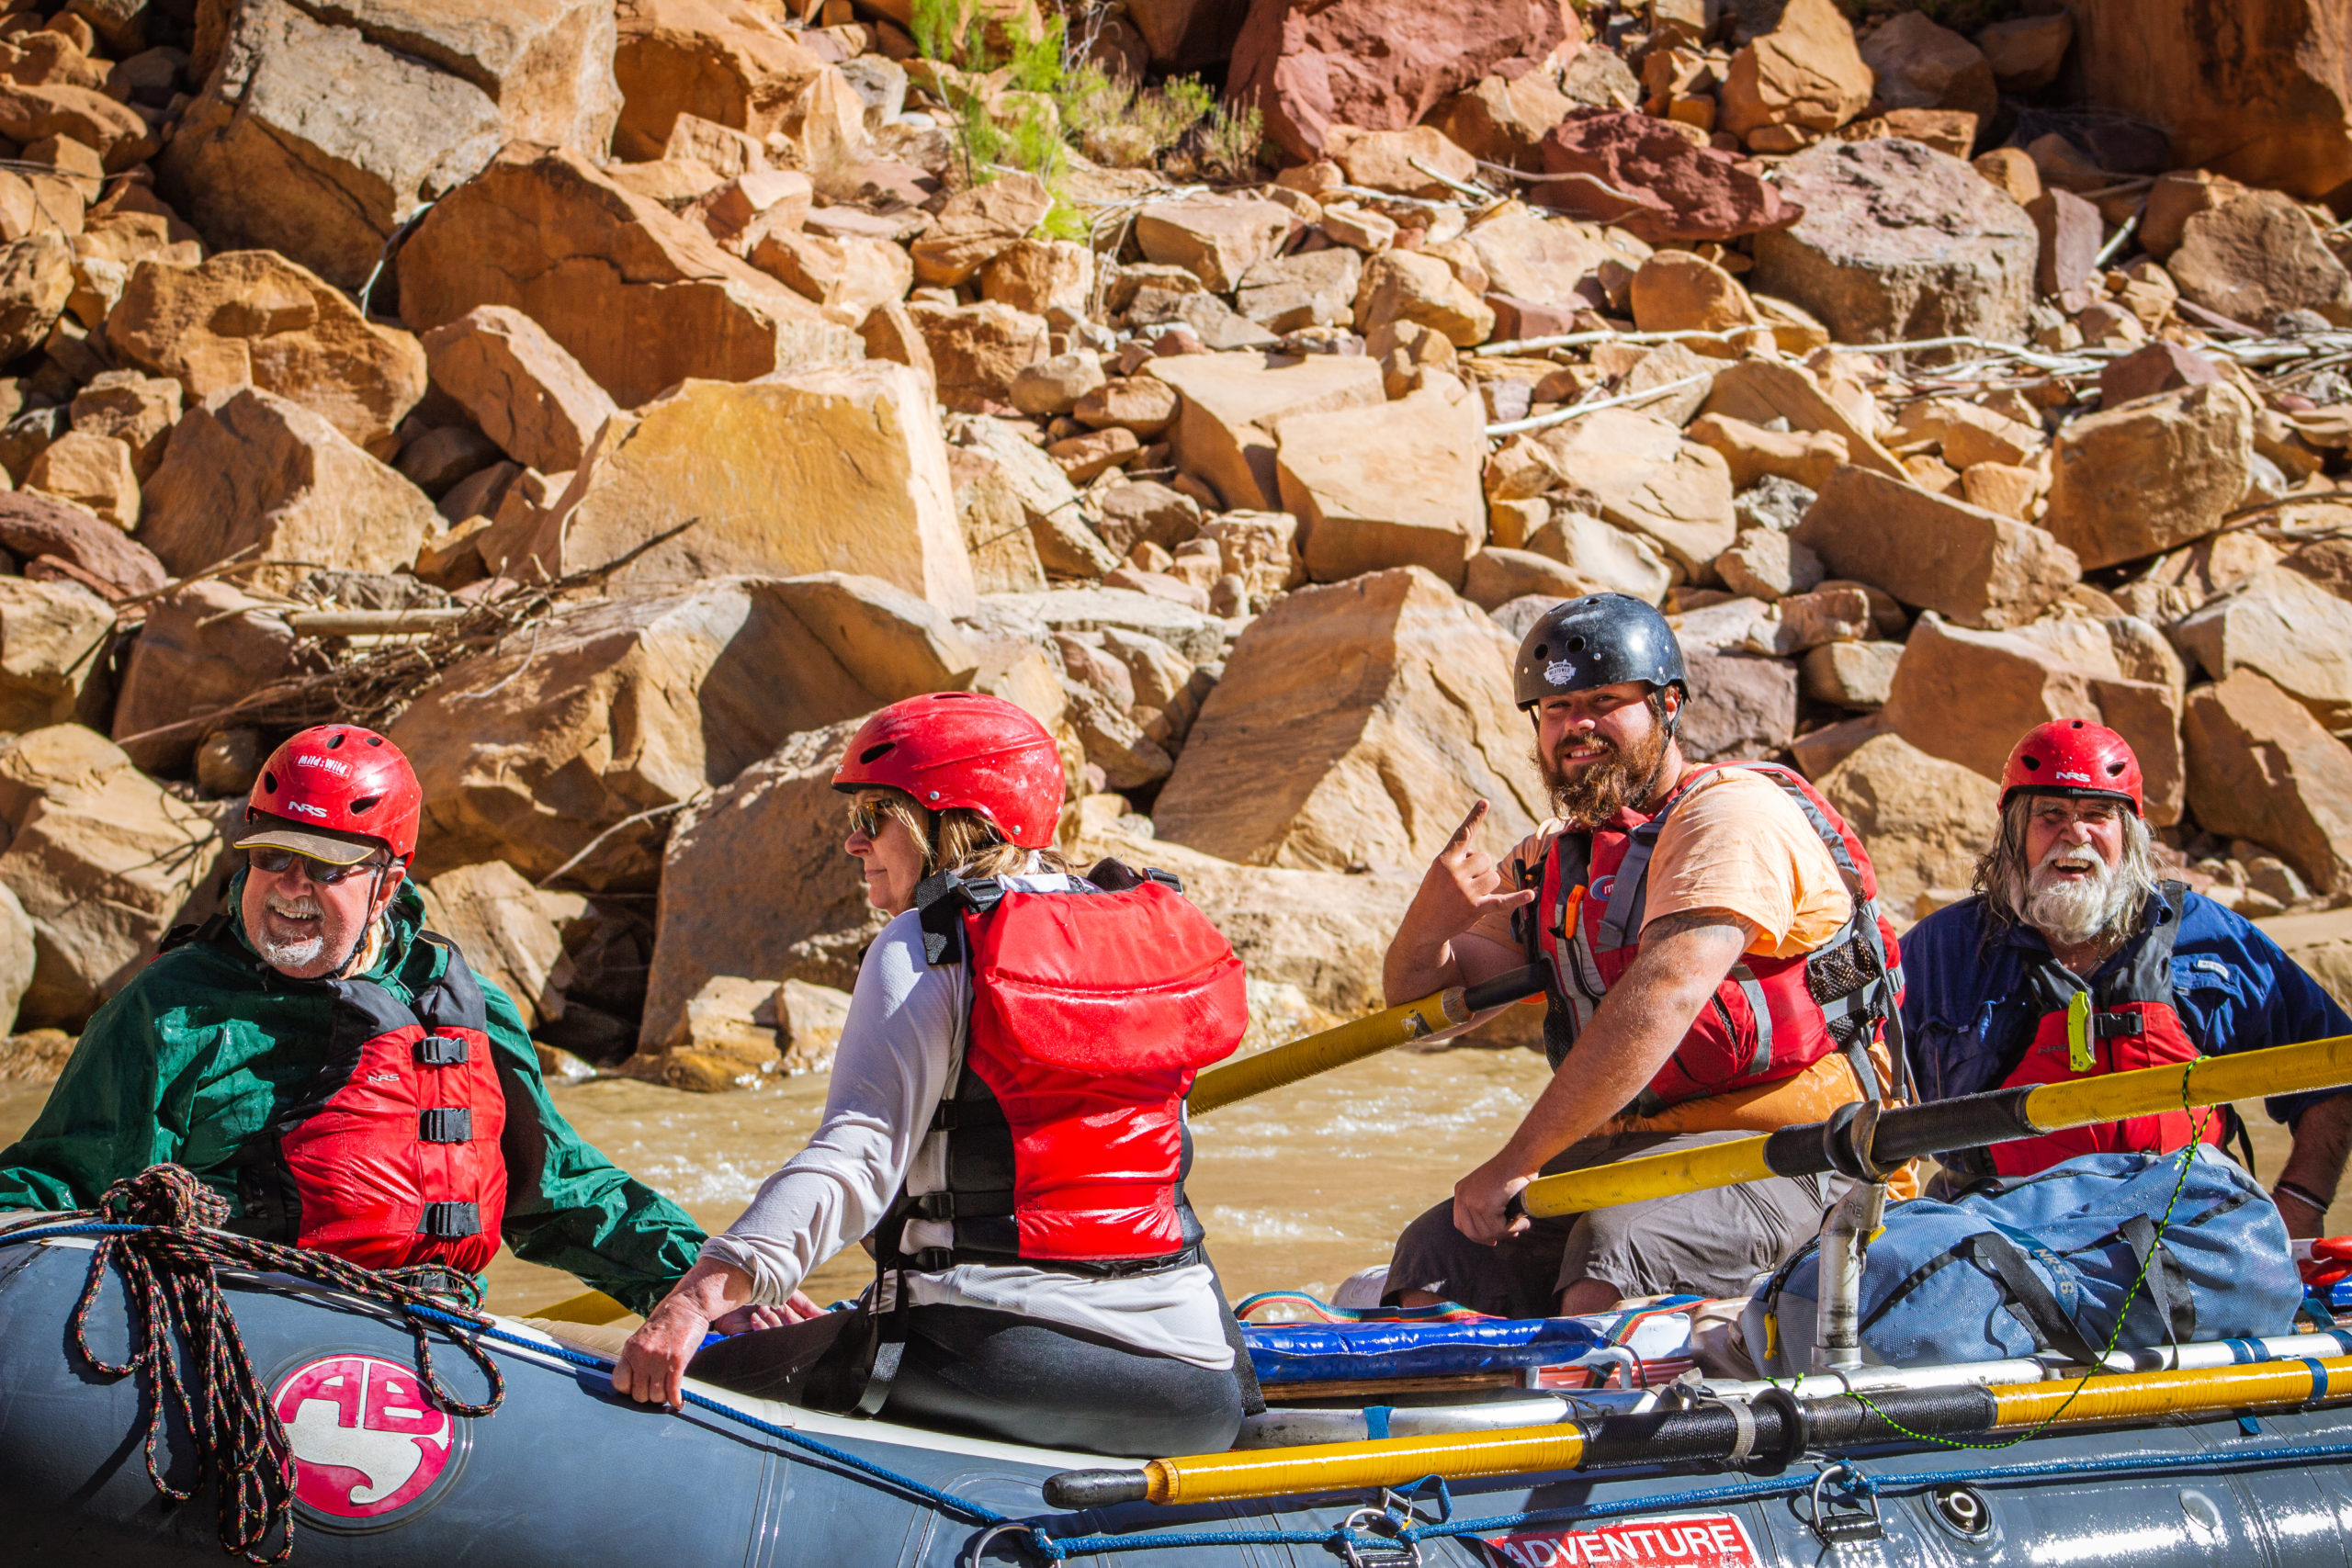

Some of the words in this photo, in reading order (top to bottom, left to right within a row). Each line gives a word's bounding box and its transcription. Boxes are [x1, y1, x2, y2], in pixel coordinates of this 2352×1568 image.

[2056, 771, 2091, 783] NRS
[288, 801, 328, 818] NRS
[367, 1073, 400, 1082] NRS
[1503, 1524, 1744, 1568] ADVENTURE
